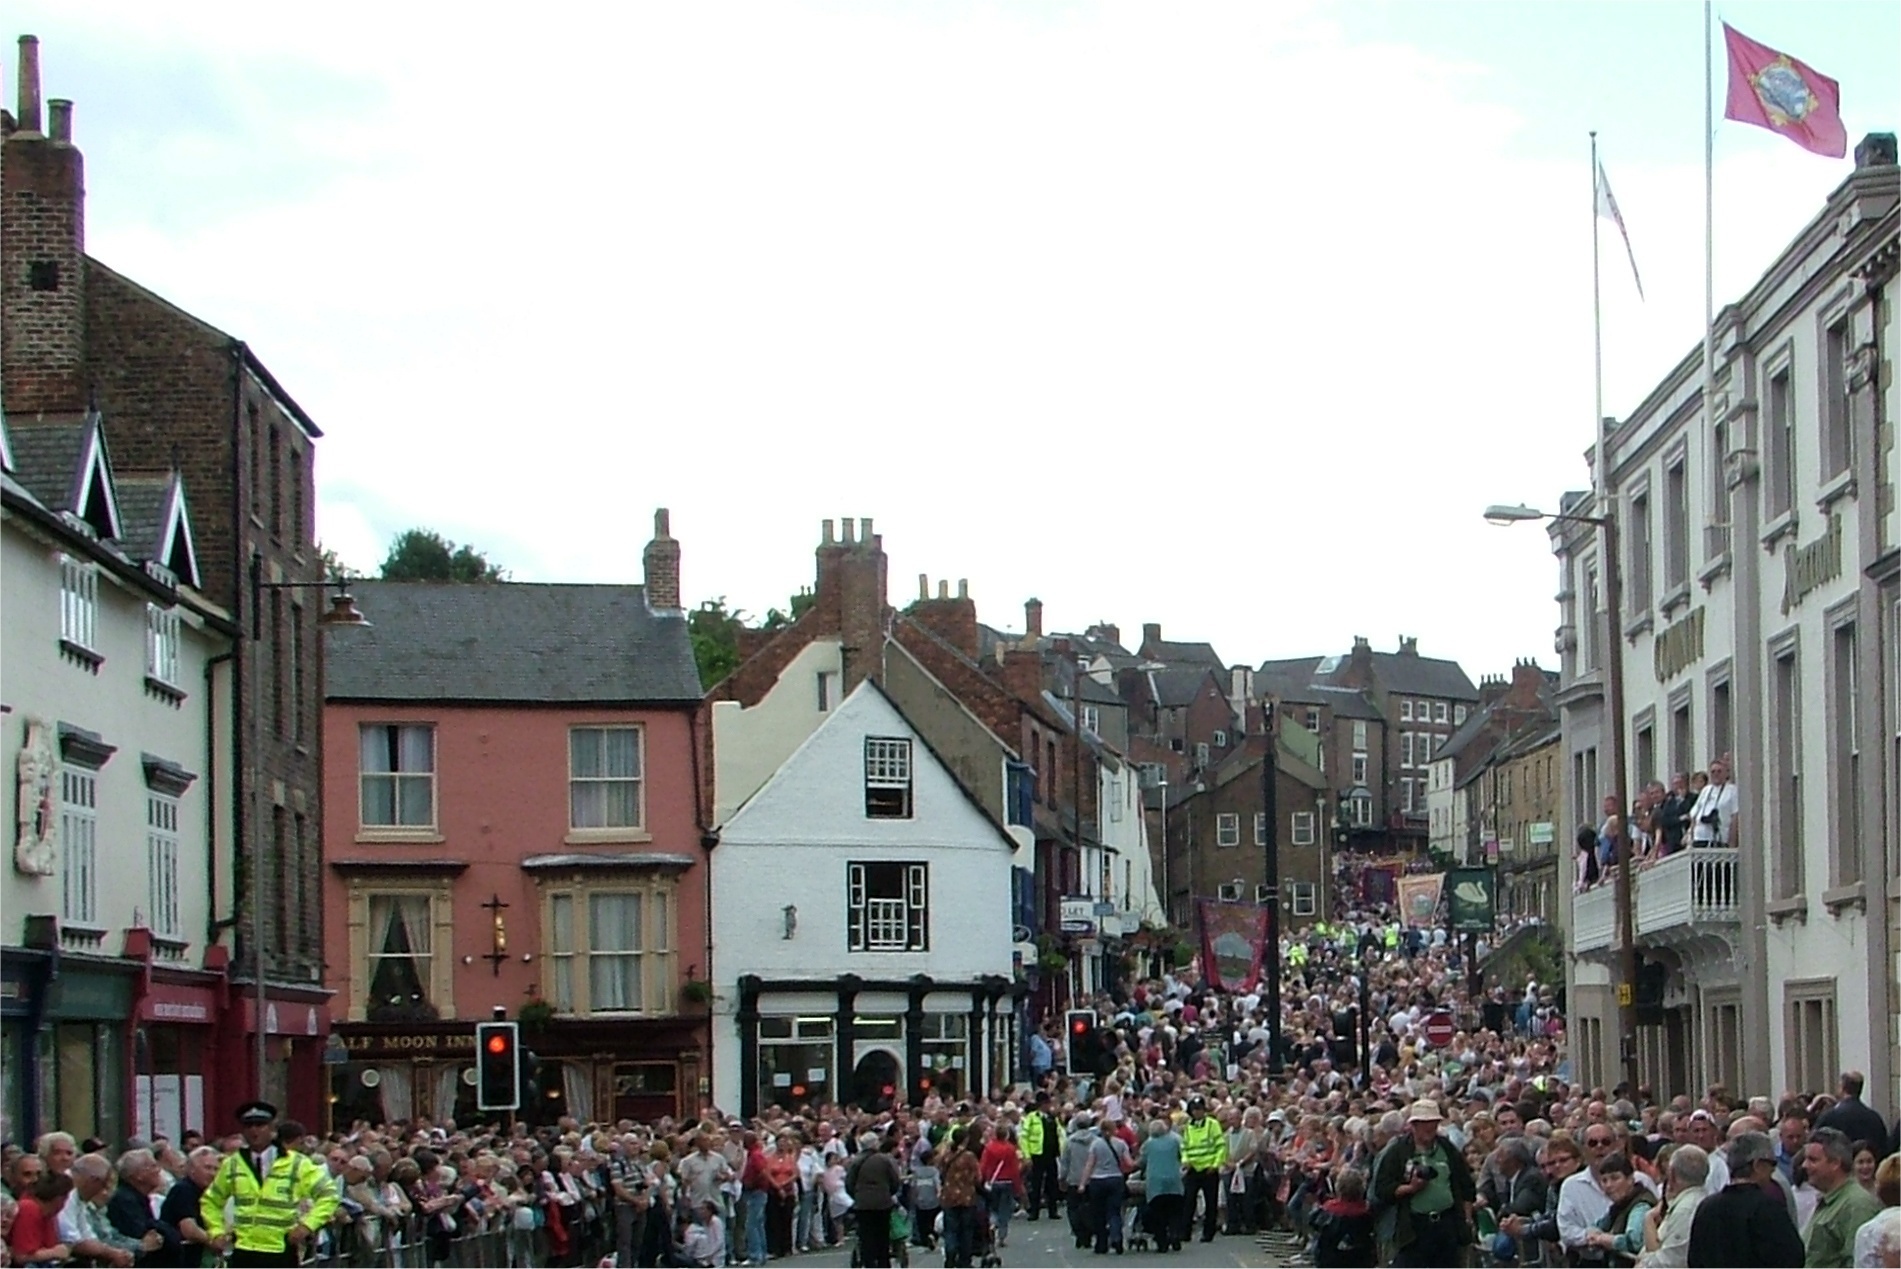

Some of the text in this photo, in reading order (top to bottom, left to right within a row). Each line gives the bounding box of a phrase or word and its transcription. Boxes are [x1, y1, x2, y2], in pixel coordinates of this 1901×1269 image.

[1068, 907, 1083, 915] LET
[335, 1035, 476, 1049] ALF MOON INN
